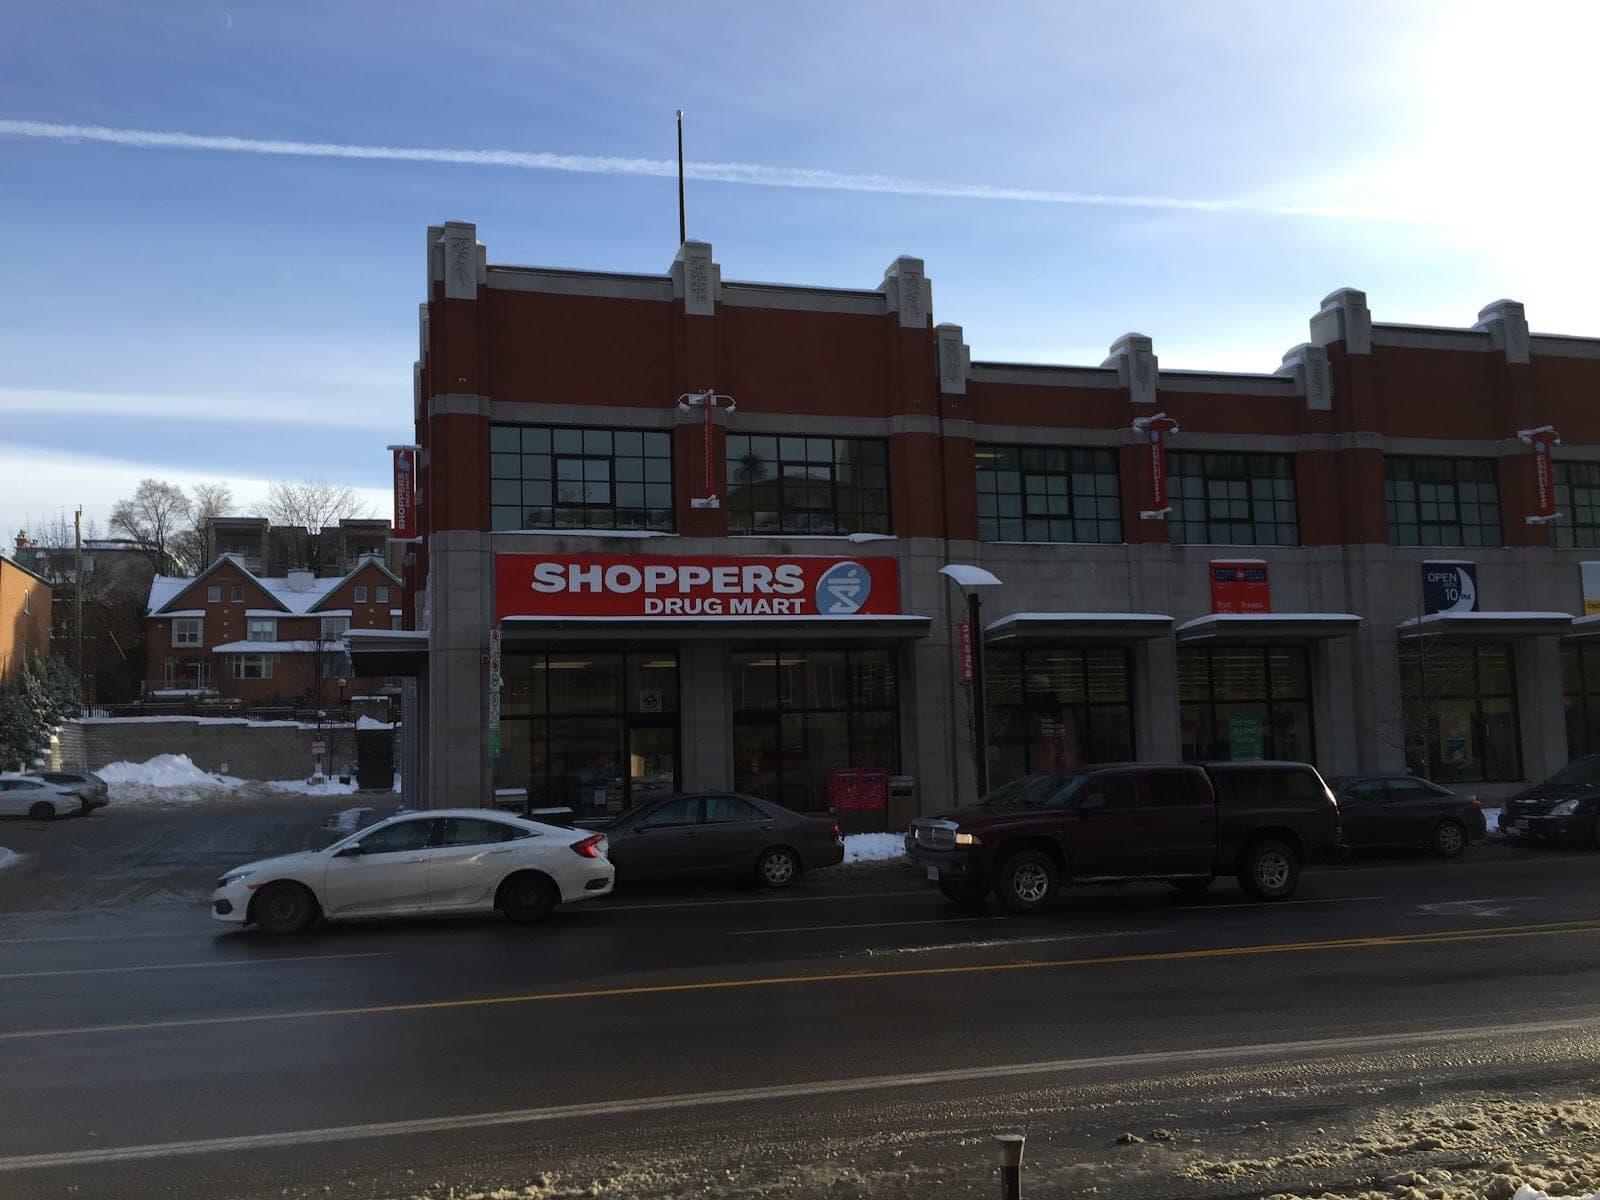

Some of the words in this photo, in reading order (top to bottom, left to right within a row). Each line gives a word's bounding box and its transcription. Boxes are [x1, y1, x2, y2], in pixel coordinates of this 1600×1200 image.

[398, 472, 406, 530] SHOPPERS
[531, 562, 805, 594] SHOPPERS
[1427, 572, 1457, 583] OPEN
[1445, 588, 1459, 601] 10
[644, 597, 723, 615] DRUG
[729, 598, 806, 614] MART
